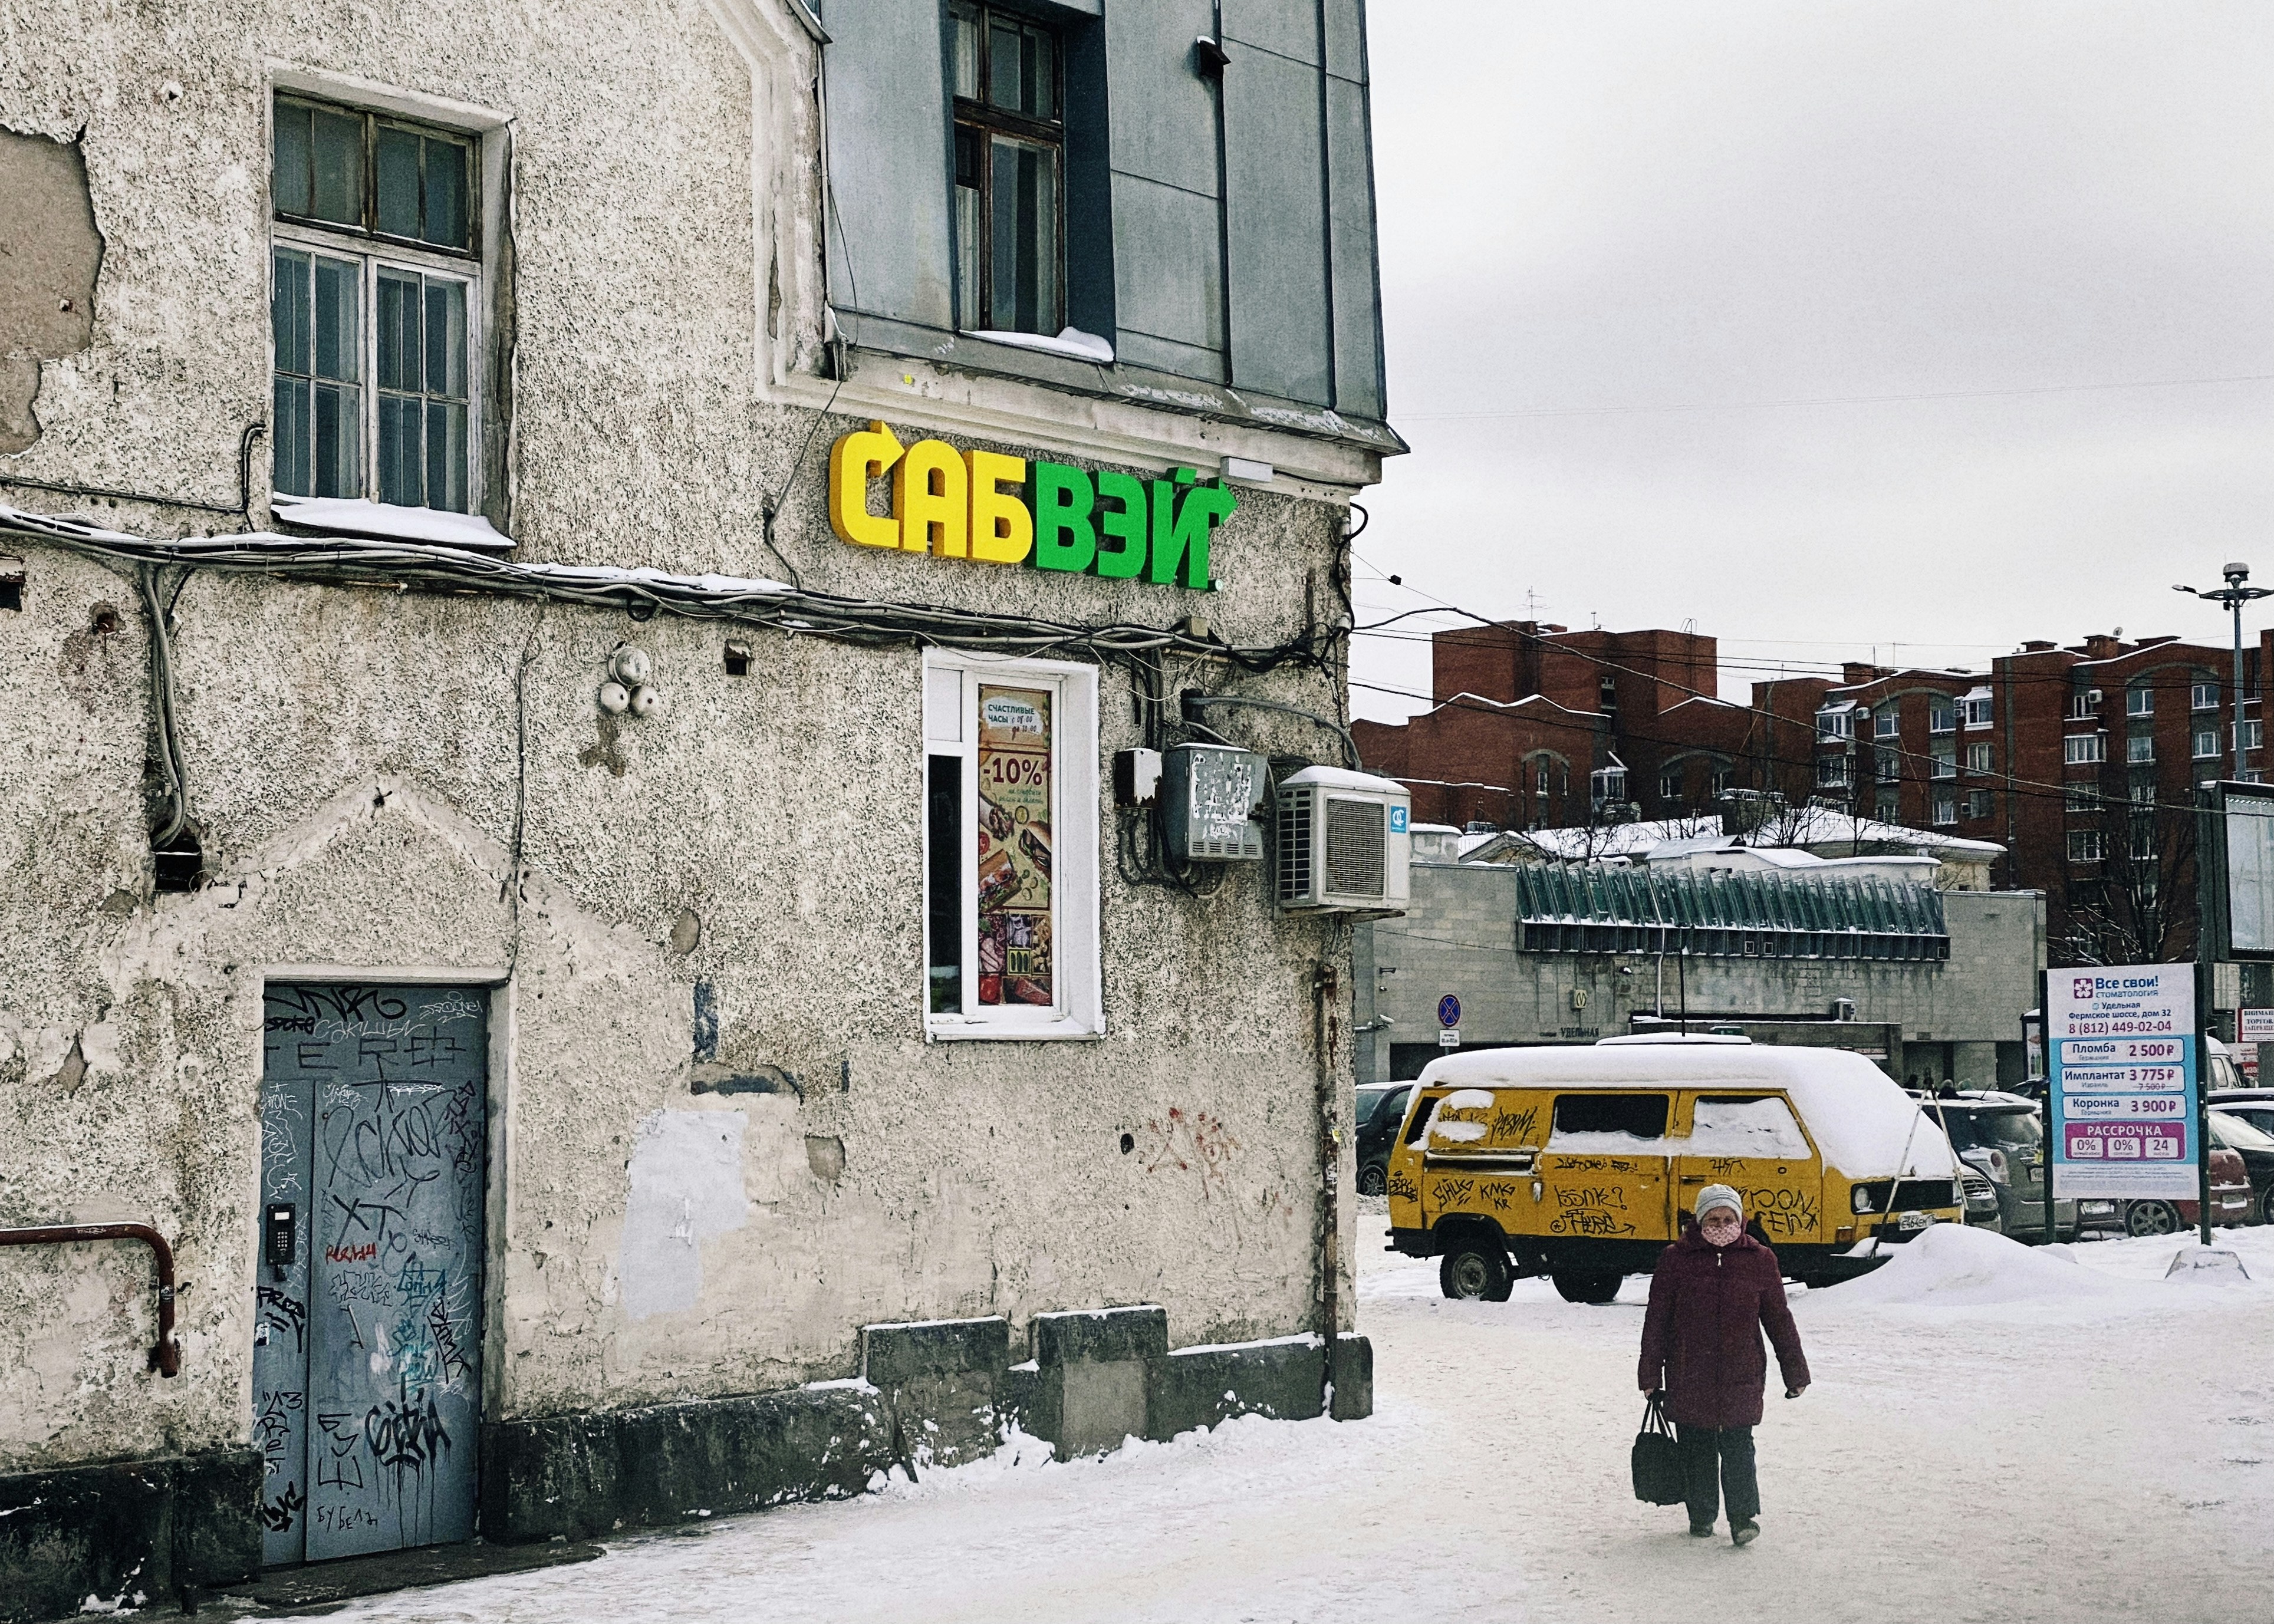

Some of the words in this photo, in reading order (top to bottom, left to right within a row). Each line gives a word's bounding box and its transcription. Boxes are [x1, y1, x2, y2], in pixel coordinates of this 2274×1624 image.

[829, 419, 1238, 588] САБВЭЙ
[988, 704, 1035, 715] СЧАСТЛИВЫЕ
[988, 714, 1008, 723] ЧАСЫ
[983, 757, 1042, 786] -10%
[2095, 977, 2120, 989] Все
[2123, 976, 2158, 988] свои!
[2096, 989, 2158, 999] стоматология
[2101, 1002, 2141, 1011] Удельная
[2068, 1012, 2110, 1020] Фермское
[2142, 1010, 2160, 1019] дом
[1561, 1027, 1600, 1038] УДЕЛЬНАЯ
[2069, 1023, 2075, 1034] 8
[2079, 1022, 2108, 1035] (812)
[2112, 1020, 2172, 1032] 449-02-04
[2072, 1043, 2116, 1053] Пломба
[2129, 1045, 2137, 1056] 2
[2065, 1070, 2125, 1081] Имплантат
[2130, 1069, 2137, 1081] 3
[2073, 1098, 2120, 1109] Коронка
[2131, 1101, 2138, 1112] 3
[2087, 1125, 2163, 1136] РАССРОЧКА
[2077, 1139, 2096, 1151] 0%
[2114, 1139, 2133, 1151] 0%
[2153, 1139, 2169, 1151] 24
